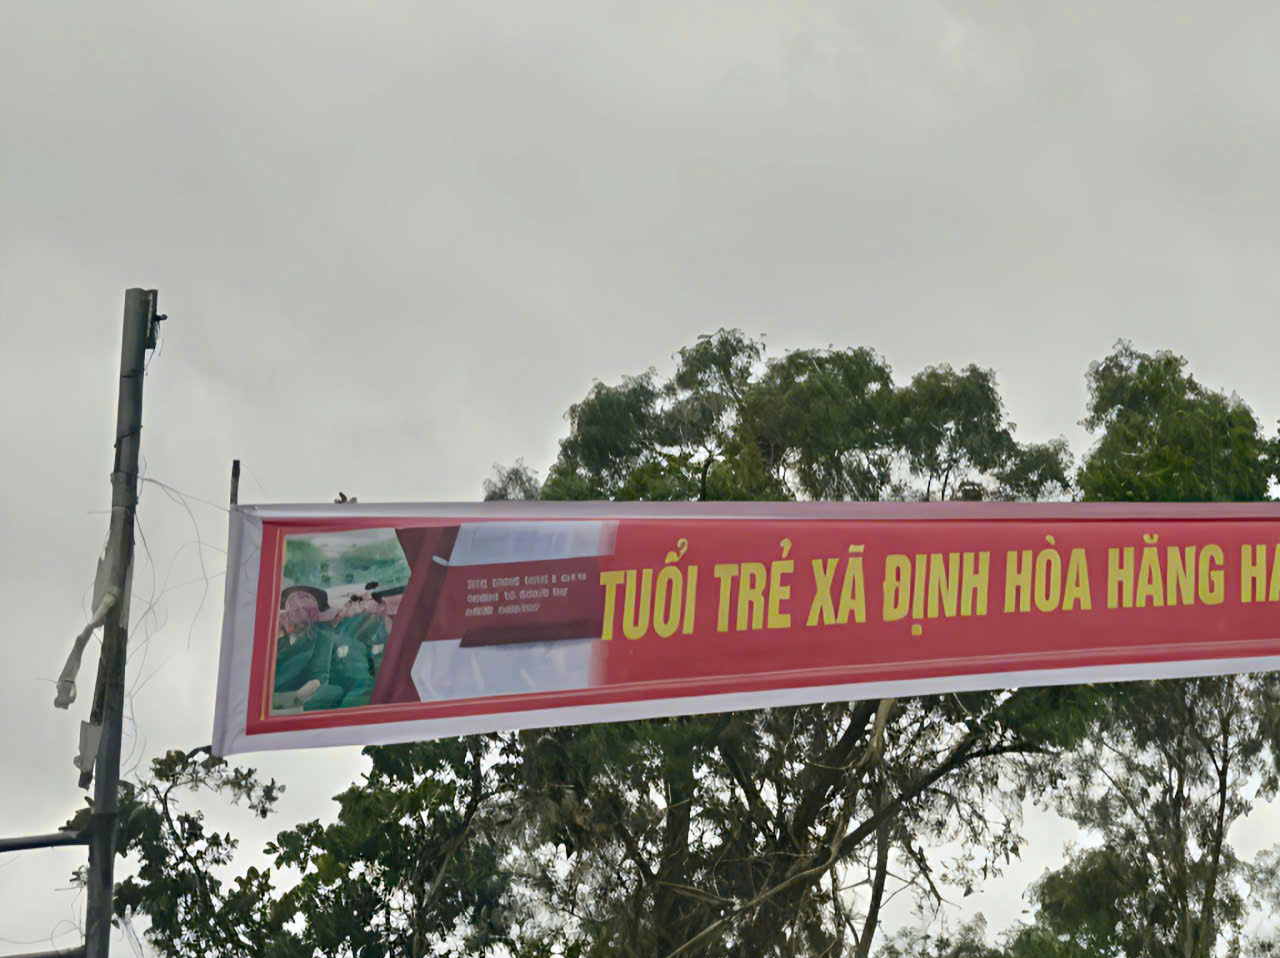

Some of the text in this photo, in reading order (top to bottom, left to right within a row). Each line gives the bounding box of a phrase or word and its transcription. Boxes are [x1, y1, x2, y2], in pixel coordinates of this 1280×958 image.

[599, 538, 697, 641] TUỔI
[714, 538, 794, 633] TRẺ
[806, 544, 867, 627] XÃ
[882, 551, 990, 636] ĐỊNH
[1003, 535, 1092, 613] HÒA
[1107, 533, 1225, 609] HĂNG
